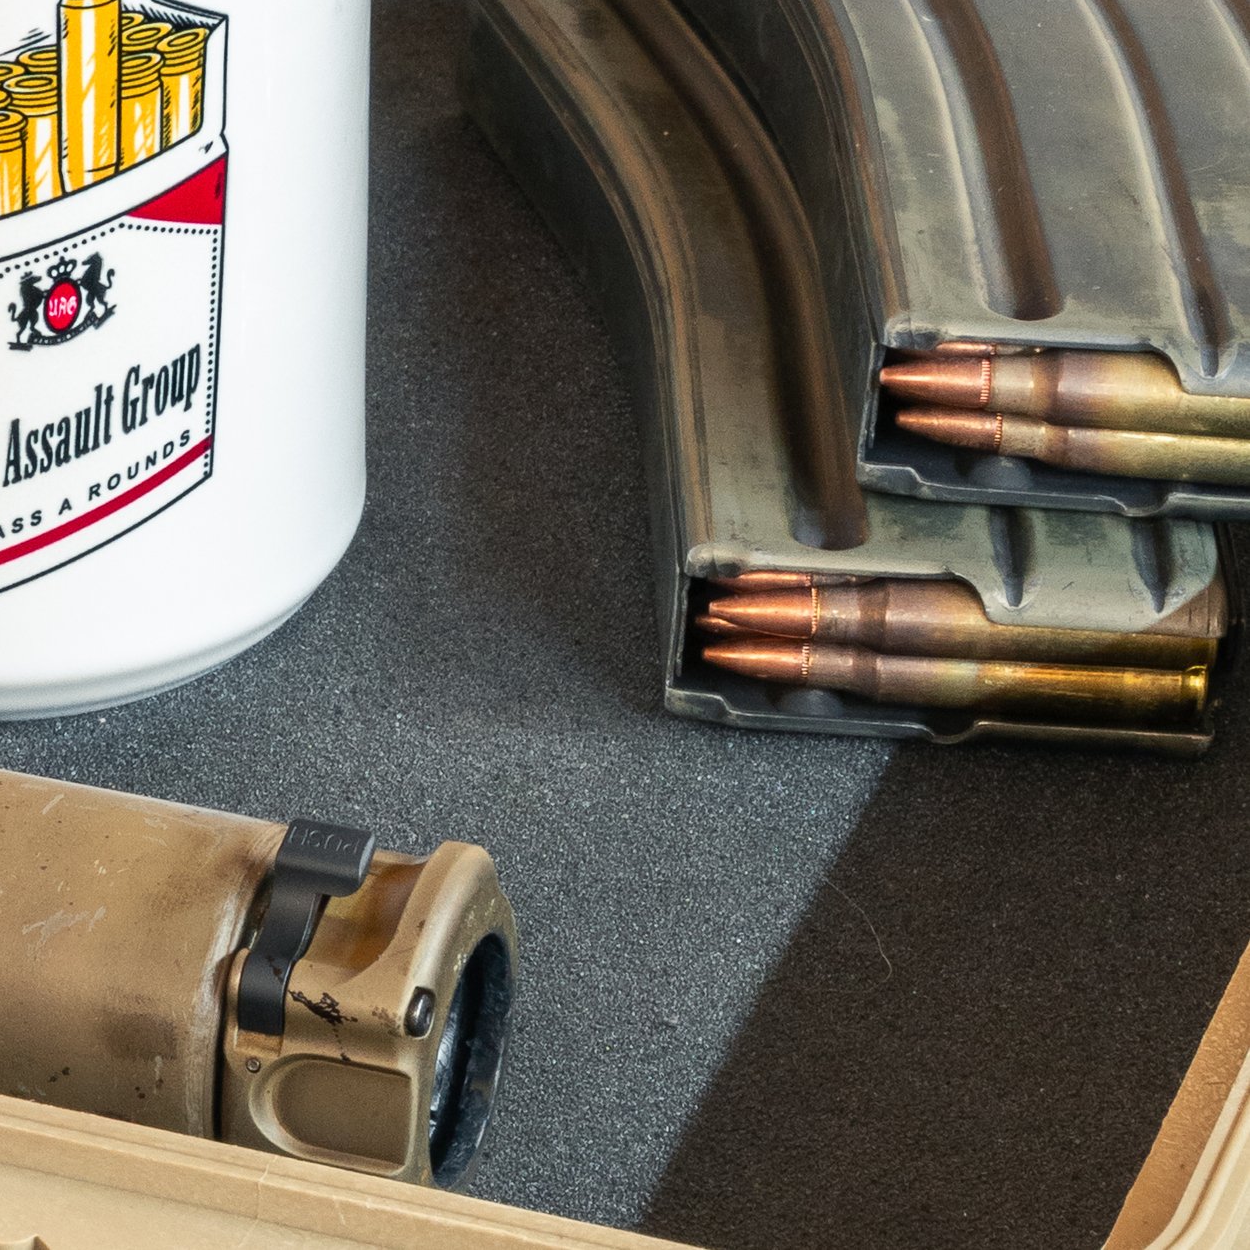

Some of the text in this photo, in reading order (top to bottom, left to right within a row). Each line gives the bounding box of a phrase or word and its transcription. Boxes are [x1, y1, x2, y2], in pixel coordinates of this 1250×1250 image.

[2, 382, 115, 488] Assault
[121, 343, 202, 435] Group
[58, 498, 73, 516] A
[87, 429, 192, 501] ROUNDS
